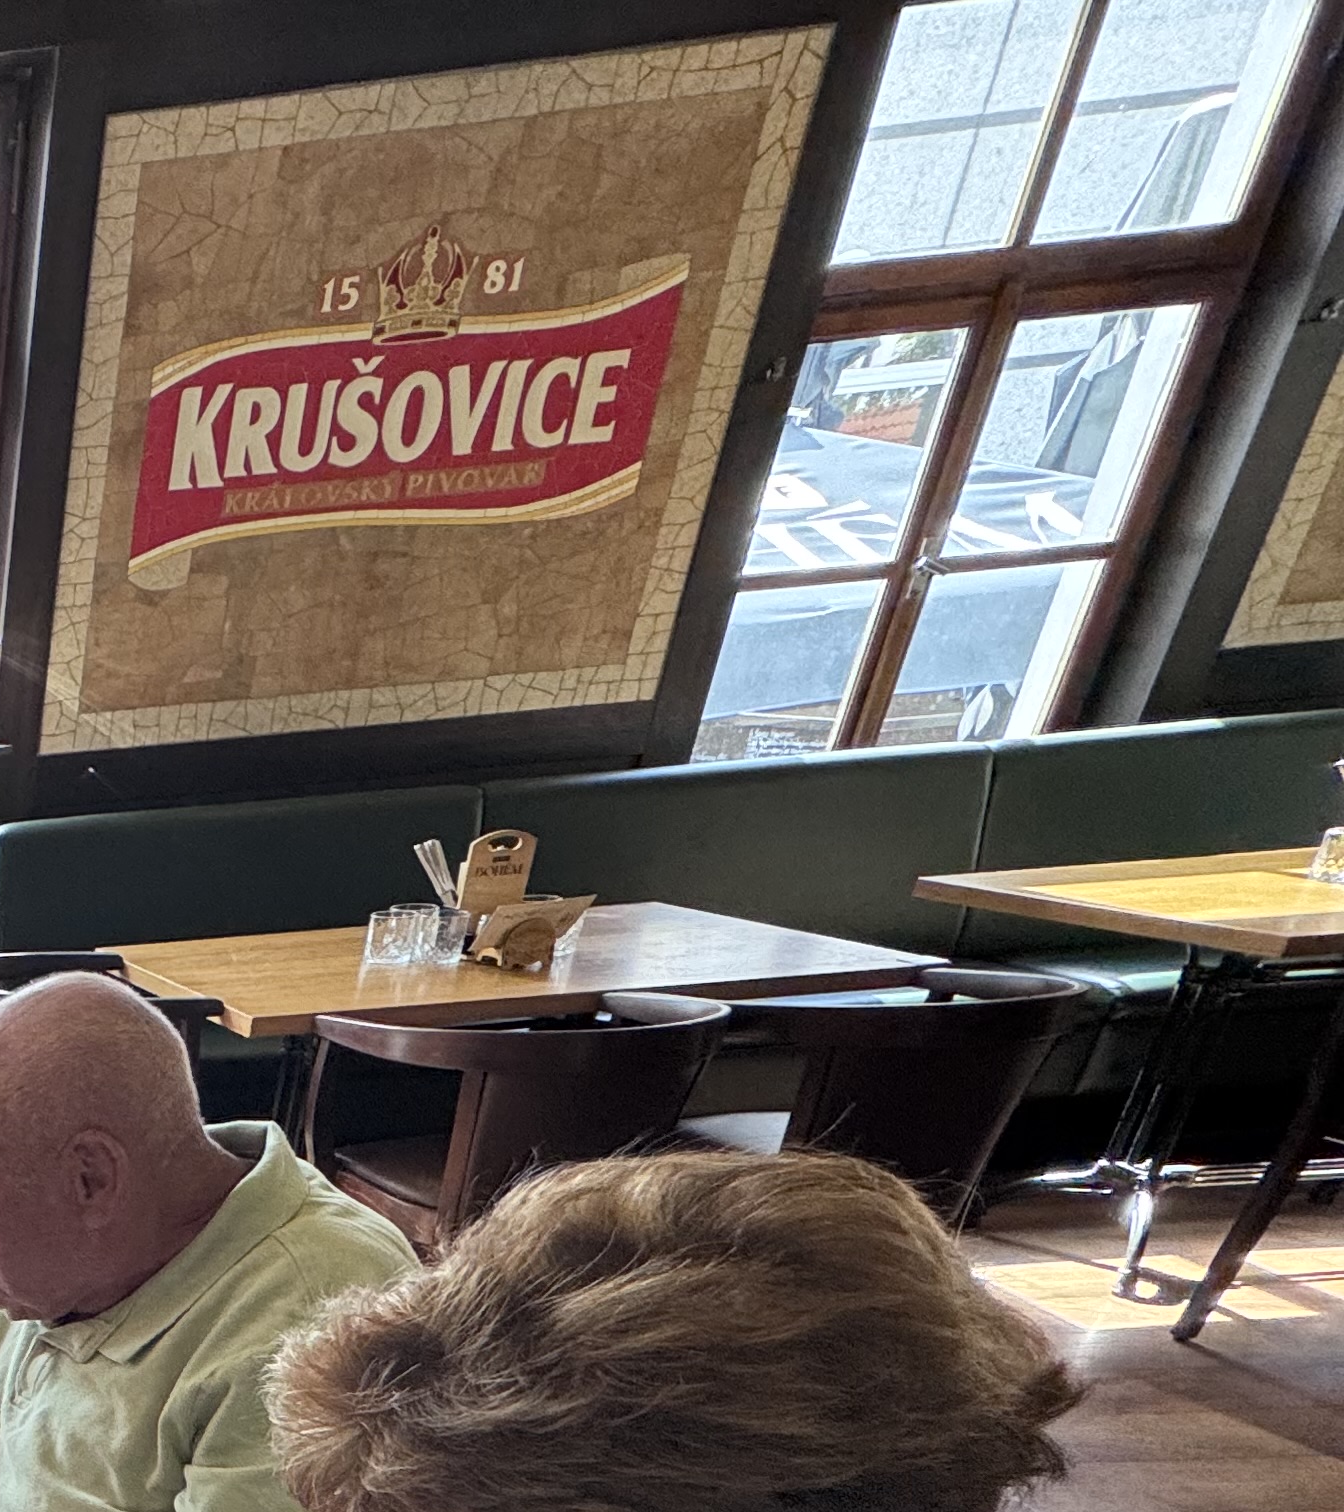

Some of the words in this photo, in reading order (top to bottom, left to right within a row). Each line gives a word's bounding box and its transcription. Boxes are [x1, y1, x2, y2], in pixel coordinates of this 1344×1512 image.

[320, 275, 360, 313] 15
[483, 257, 525, 294] 81
[167, 349, 631, 491] KRUŠOVICE
